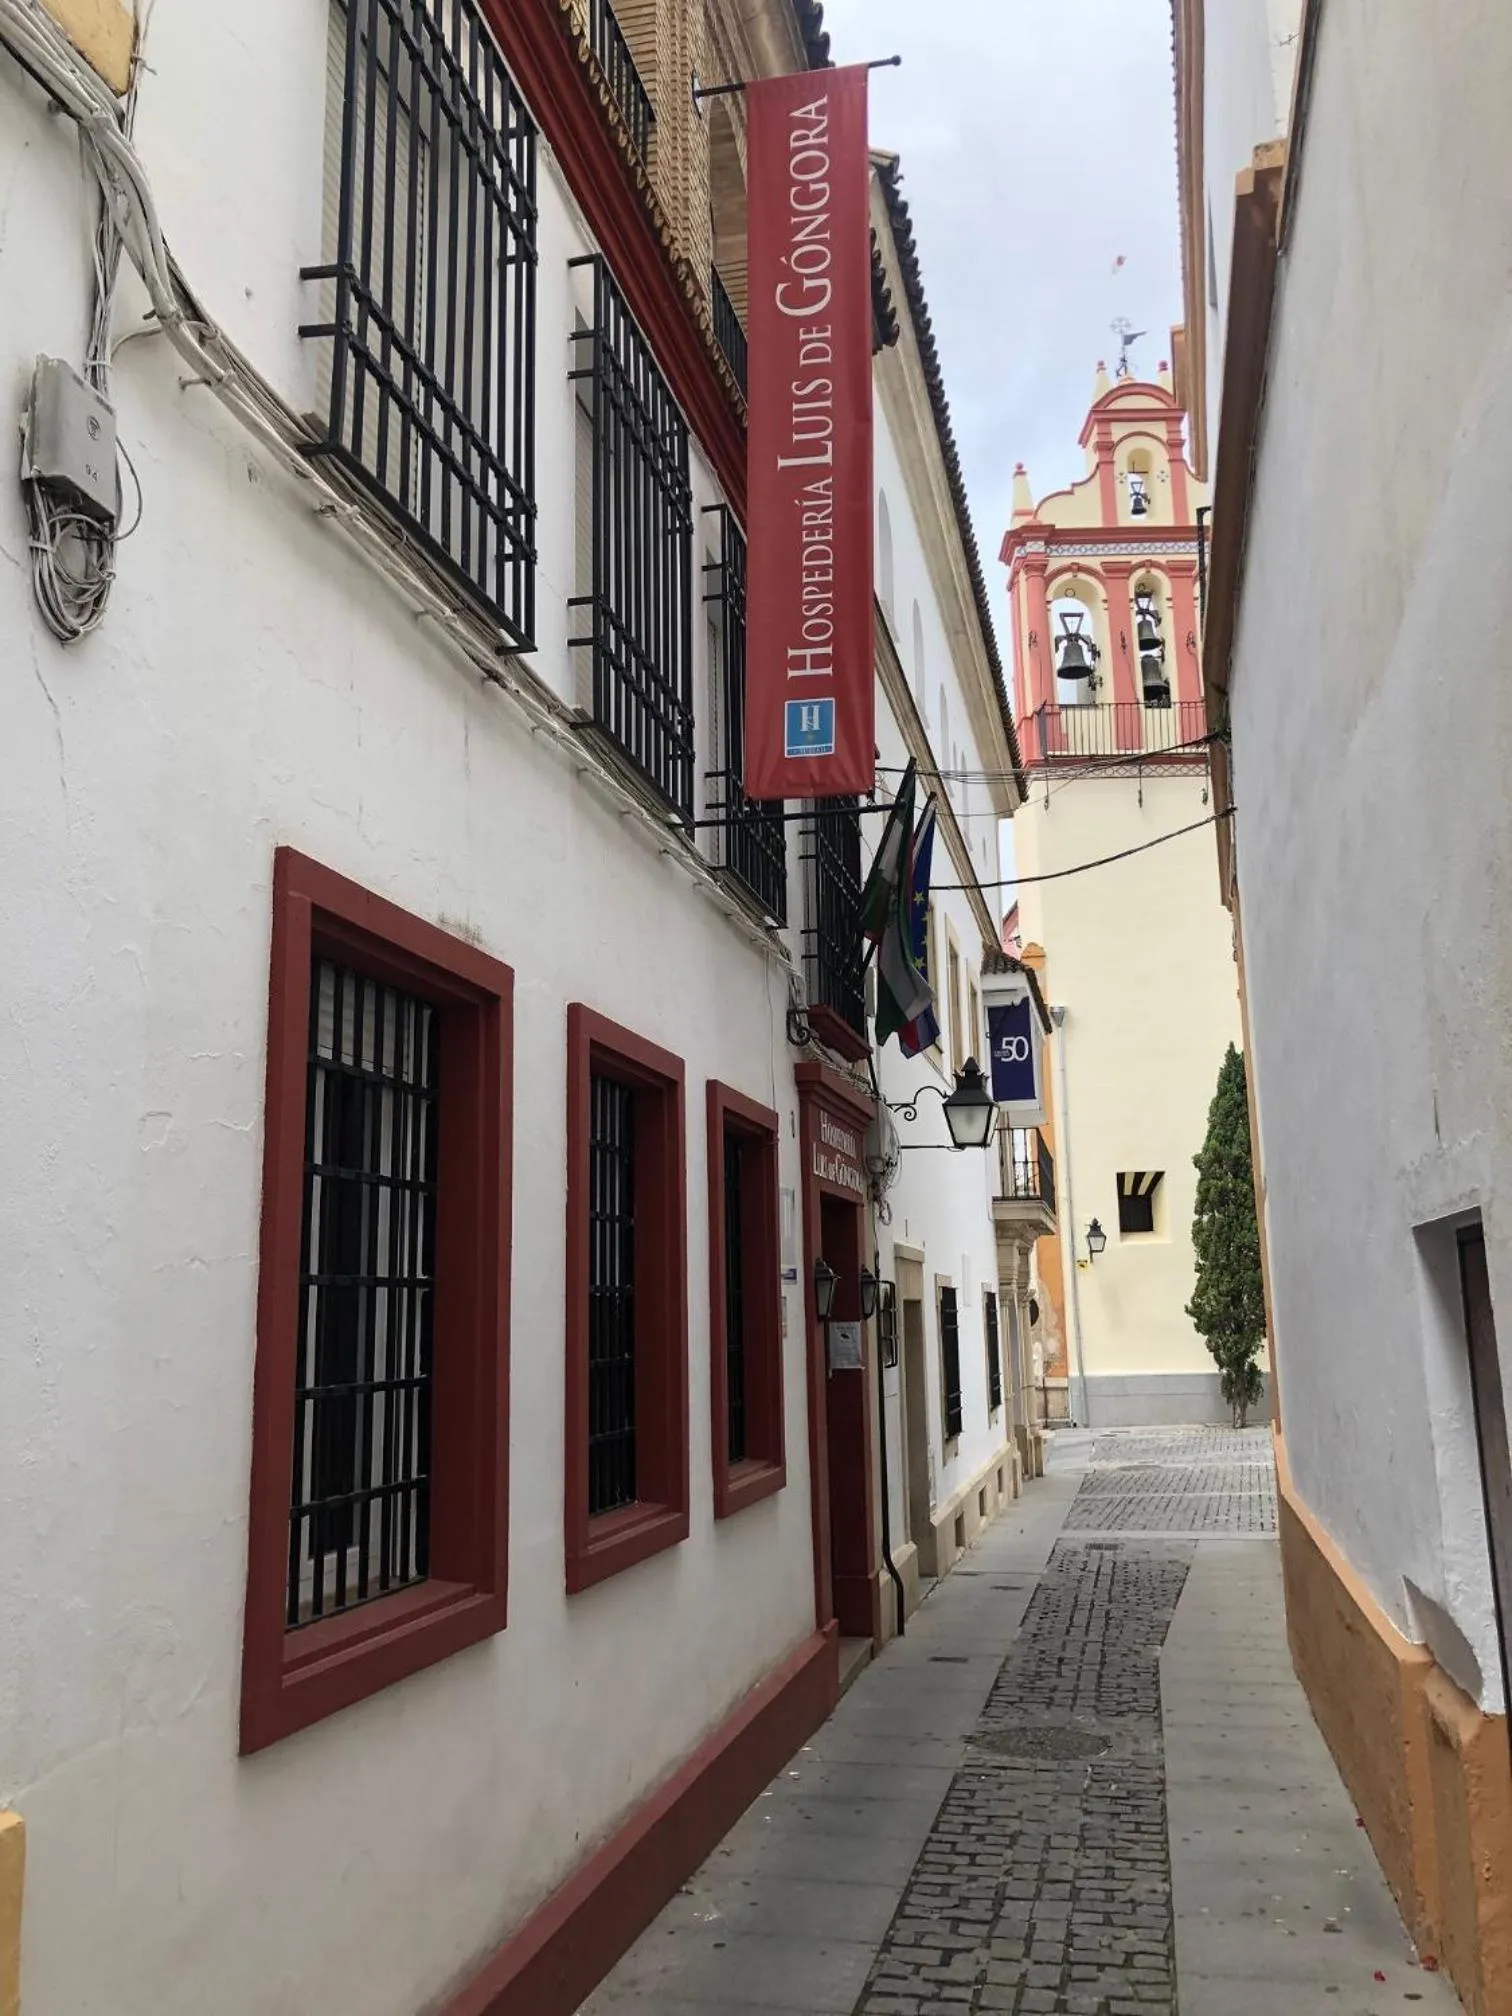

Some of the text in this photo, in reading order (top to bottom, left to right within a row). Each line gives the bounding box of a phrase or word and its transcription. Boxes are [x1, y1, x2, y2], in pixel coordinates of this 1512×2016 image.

[775, 93, 834, 681] HOSPEDERÍA LUIS DE GÓNGORA
[1000, 1035, 1029, 1062] 50
[819, 1109, 857, 1160] HORÍA
